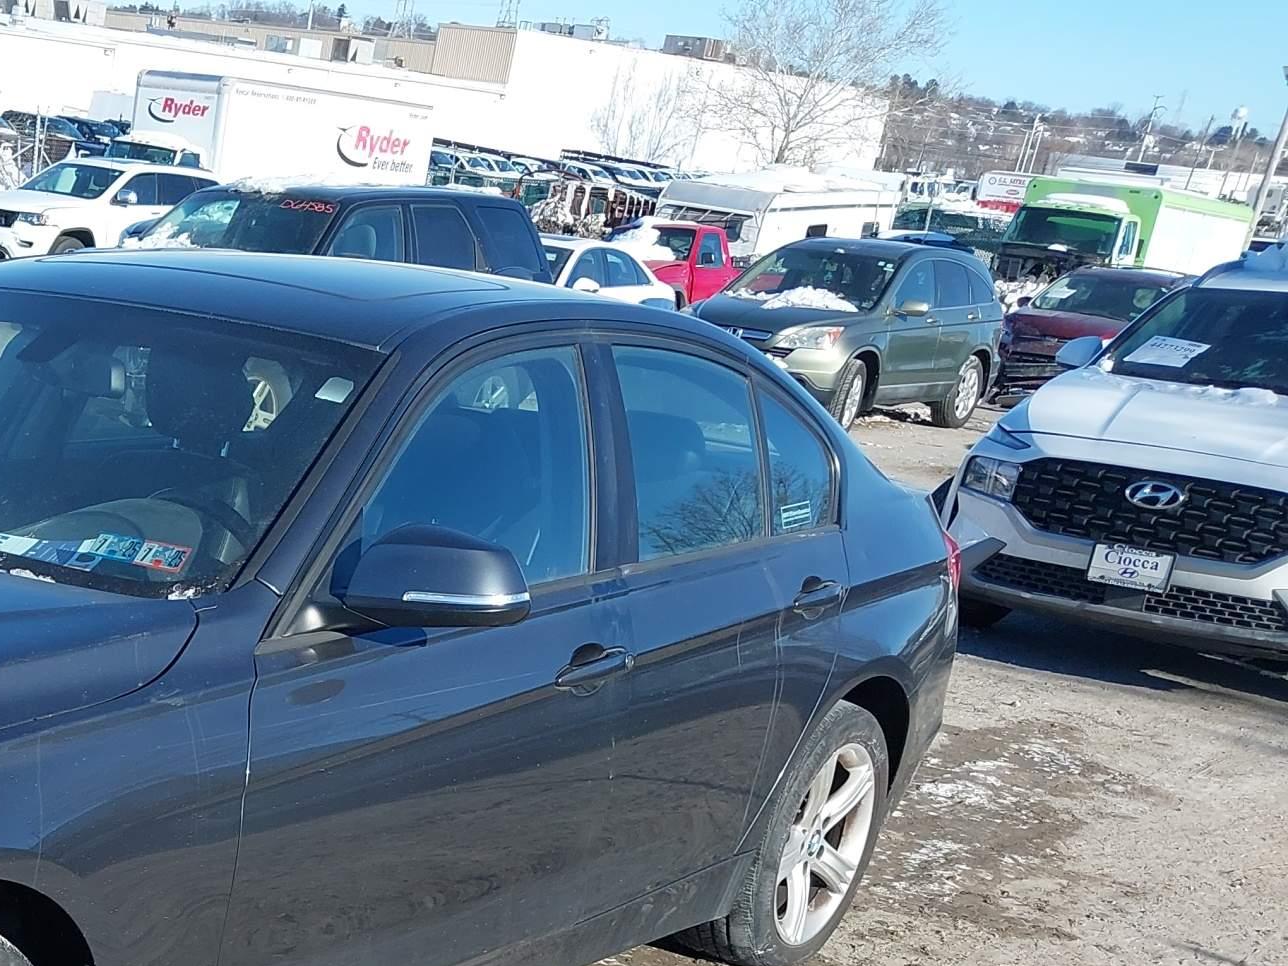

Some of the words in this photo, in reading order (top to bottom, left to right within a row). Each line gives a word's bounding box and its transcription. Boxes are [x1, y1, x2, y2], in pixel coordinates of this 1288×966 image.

[162, 97, 209, 118] Ryder
[354, 125, 411, 158] Ryder
[372, 156, 390, 170] Ever
[1104, 550, 1159, 571] Ciocca
